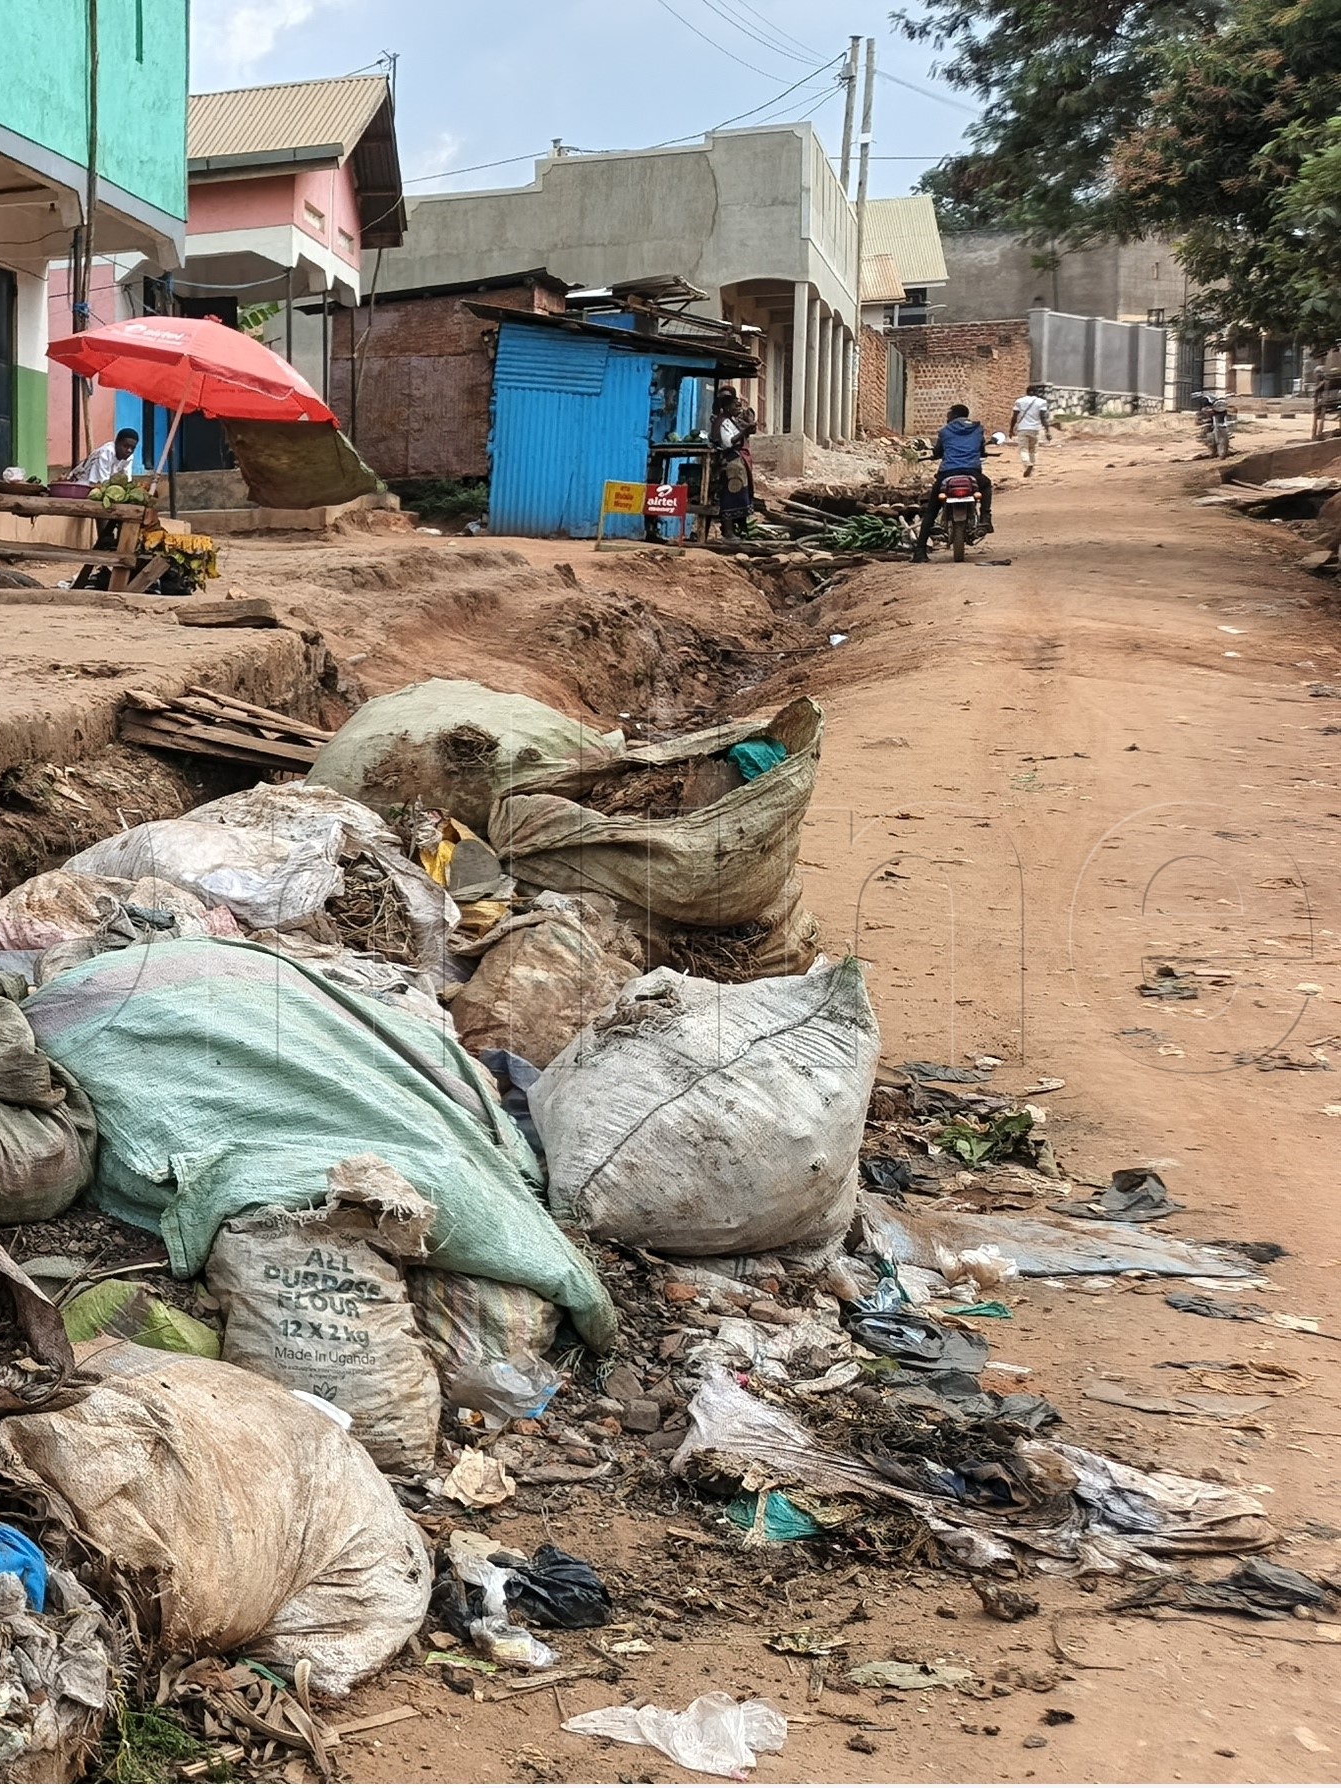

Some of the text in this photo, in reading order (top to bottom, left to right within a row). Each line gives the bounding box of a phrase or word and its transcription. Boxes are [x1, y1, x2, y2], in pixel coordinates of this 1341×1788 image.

[647, 497, 677, 507] airtel
[303, 1247, 355, 1274] ALL
[263, 1263, 382, 1299] PURPOSE
[277, 1289, 360, 1319] FLOUR
[279, 1319, 303, 1338] 12
[274, 1346, 313, 1361] Made
[328, 1350, 377, 1367] Uganda
